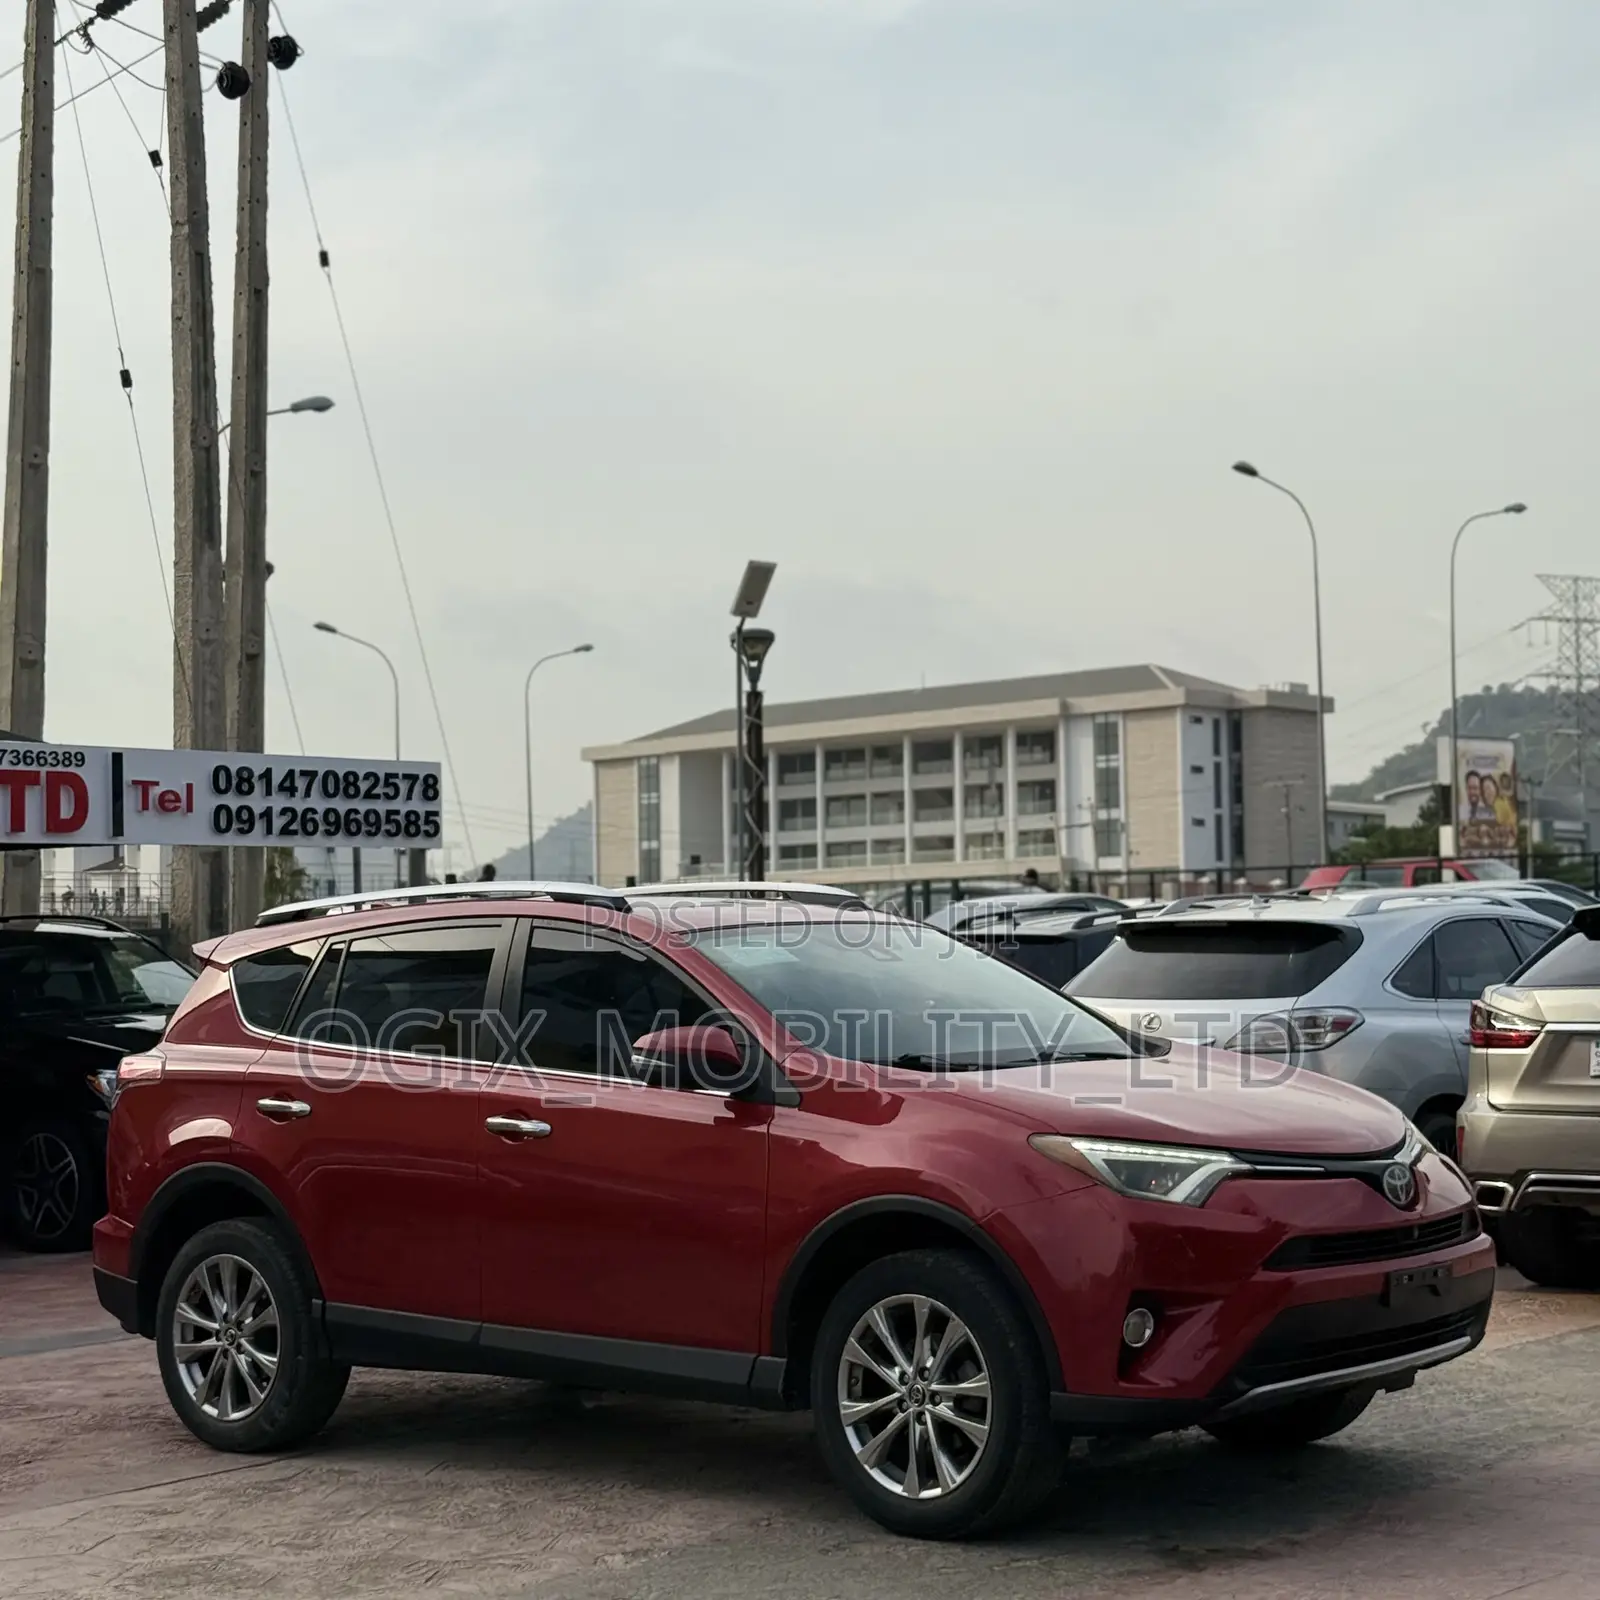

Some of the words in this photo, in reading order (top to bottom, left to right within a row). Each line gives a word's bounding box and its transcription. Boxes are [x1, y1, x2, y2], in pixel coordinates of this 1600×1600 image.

[0, 749, 85, 768] 7366389
[131, 779, 194, 813] Tel
[212, 764, 440, 802] 08147082578
[0, 769, 89, 834] TD
[213, 803, 441, 838] 09126969585
